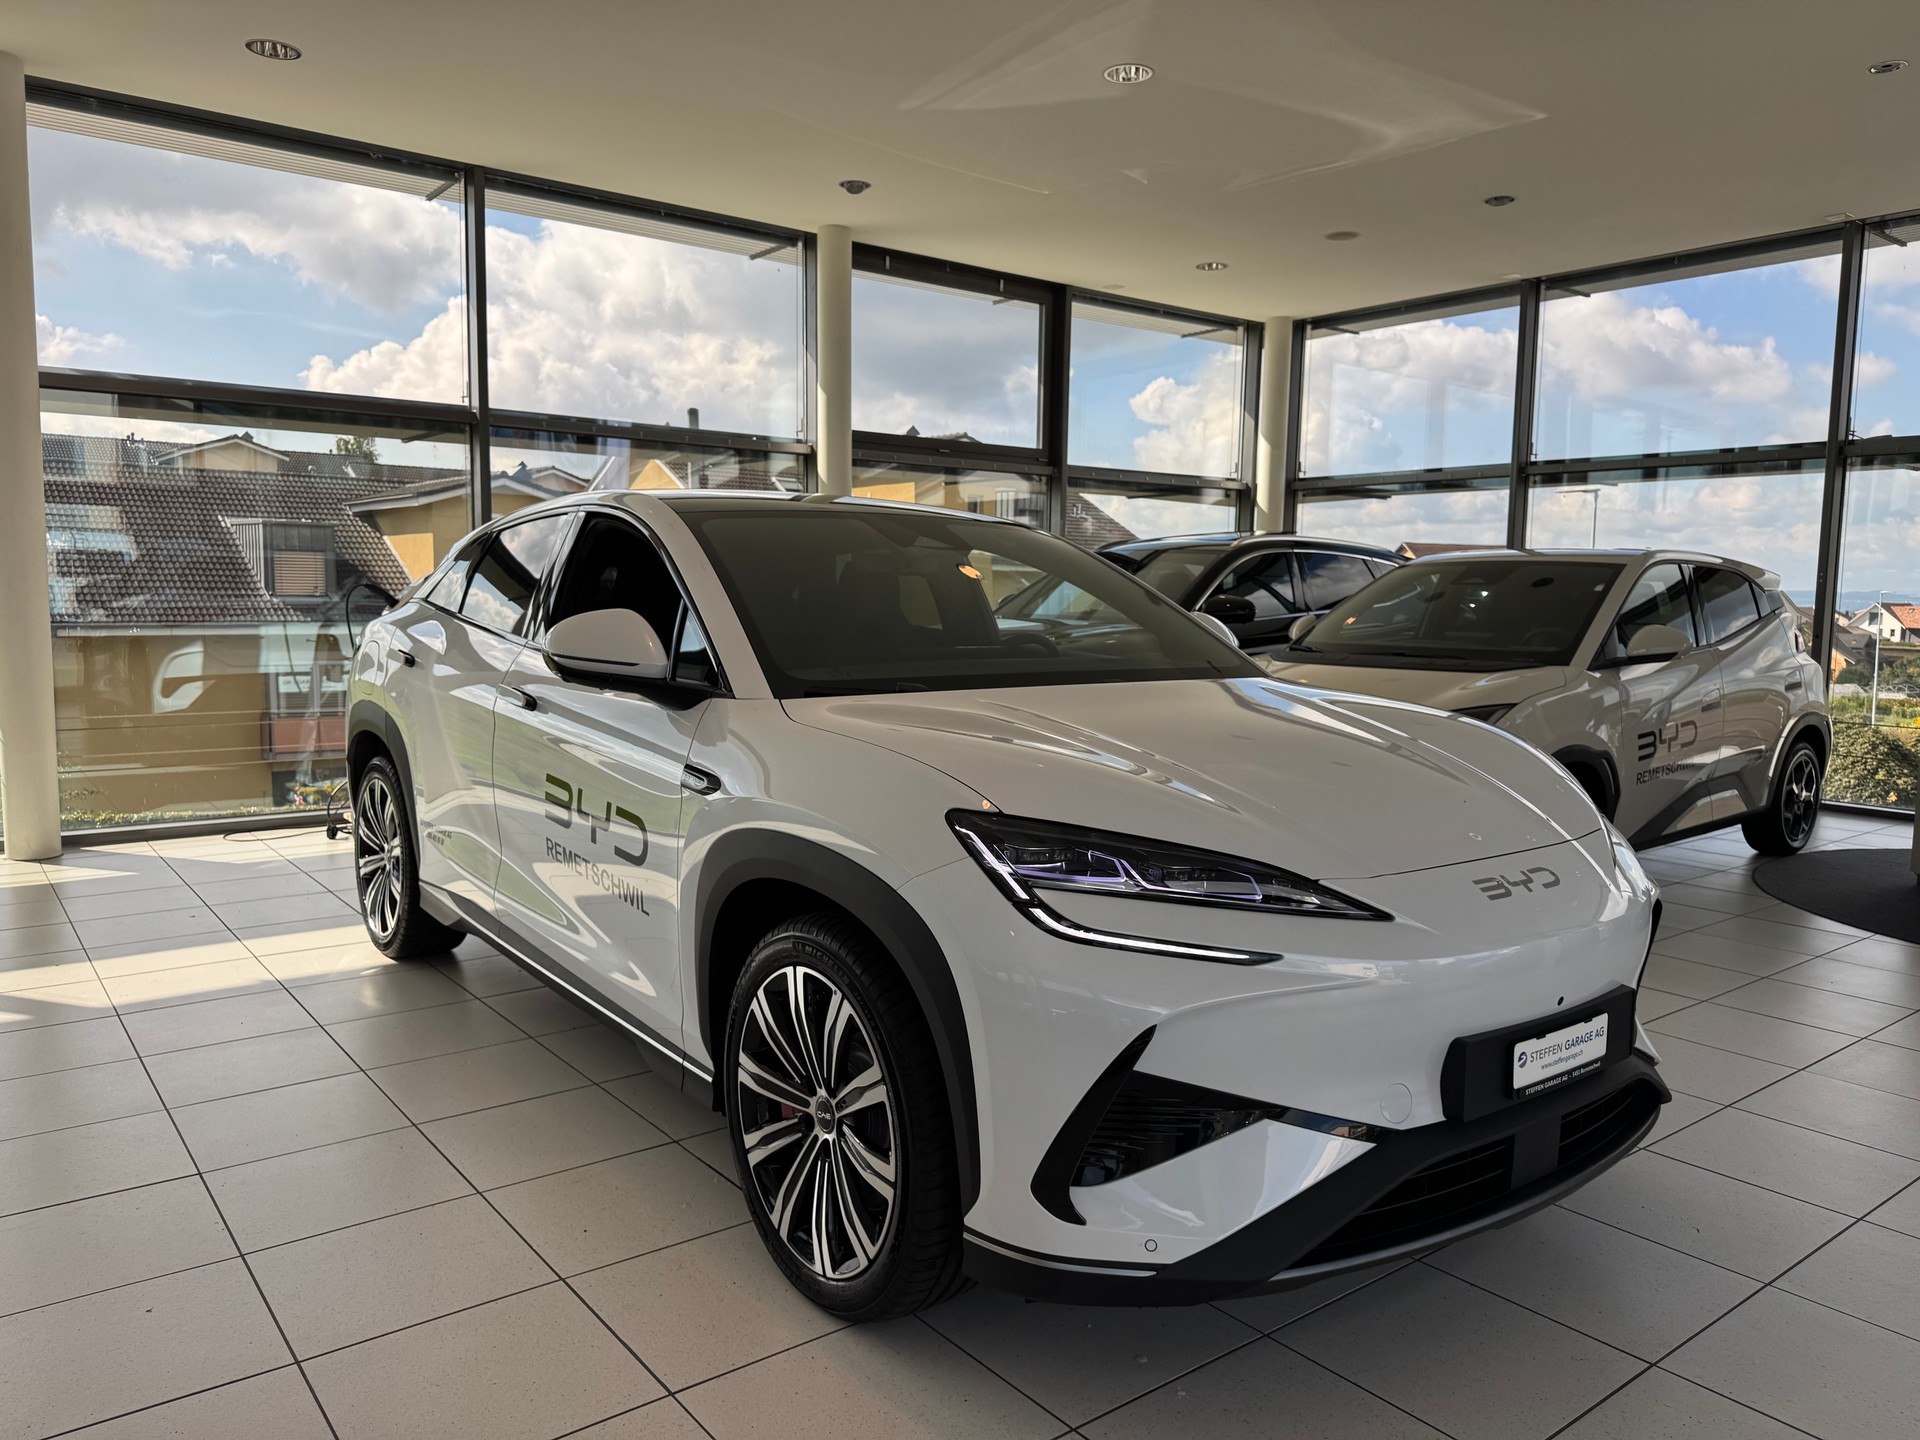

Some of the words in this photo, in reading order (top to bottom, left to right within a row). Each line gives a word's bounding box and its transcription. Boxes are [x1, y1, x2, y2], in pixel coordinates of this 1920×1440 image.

[1637, 720, 1698, 762] BYD
[545, 773, 649, 867] BYD
[546, 837, 650, 916] REMETSCHWIL
[1472, 866, 1560, 901] BYD
[804, 946, 850, 985] MICHELIN
[1530, 1042, 1563, 1063] STEFFEN
[1564, 1030, 1594, 1051] GARAGE
[1594, 1026, 1605, 1039] AG
[1525, 1084, 1544, 1096] STEFFEN
[1544, 1076, 1562, 1089] GARAGE
[1561, 1074, 1569, 1083] AG
